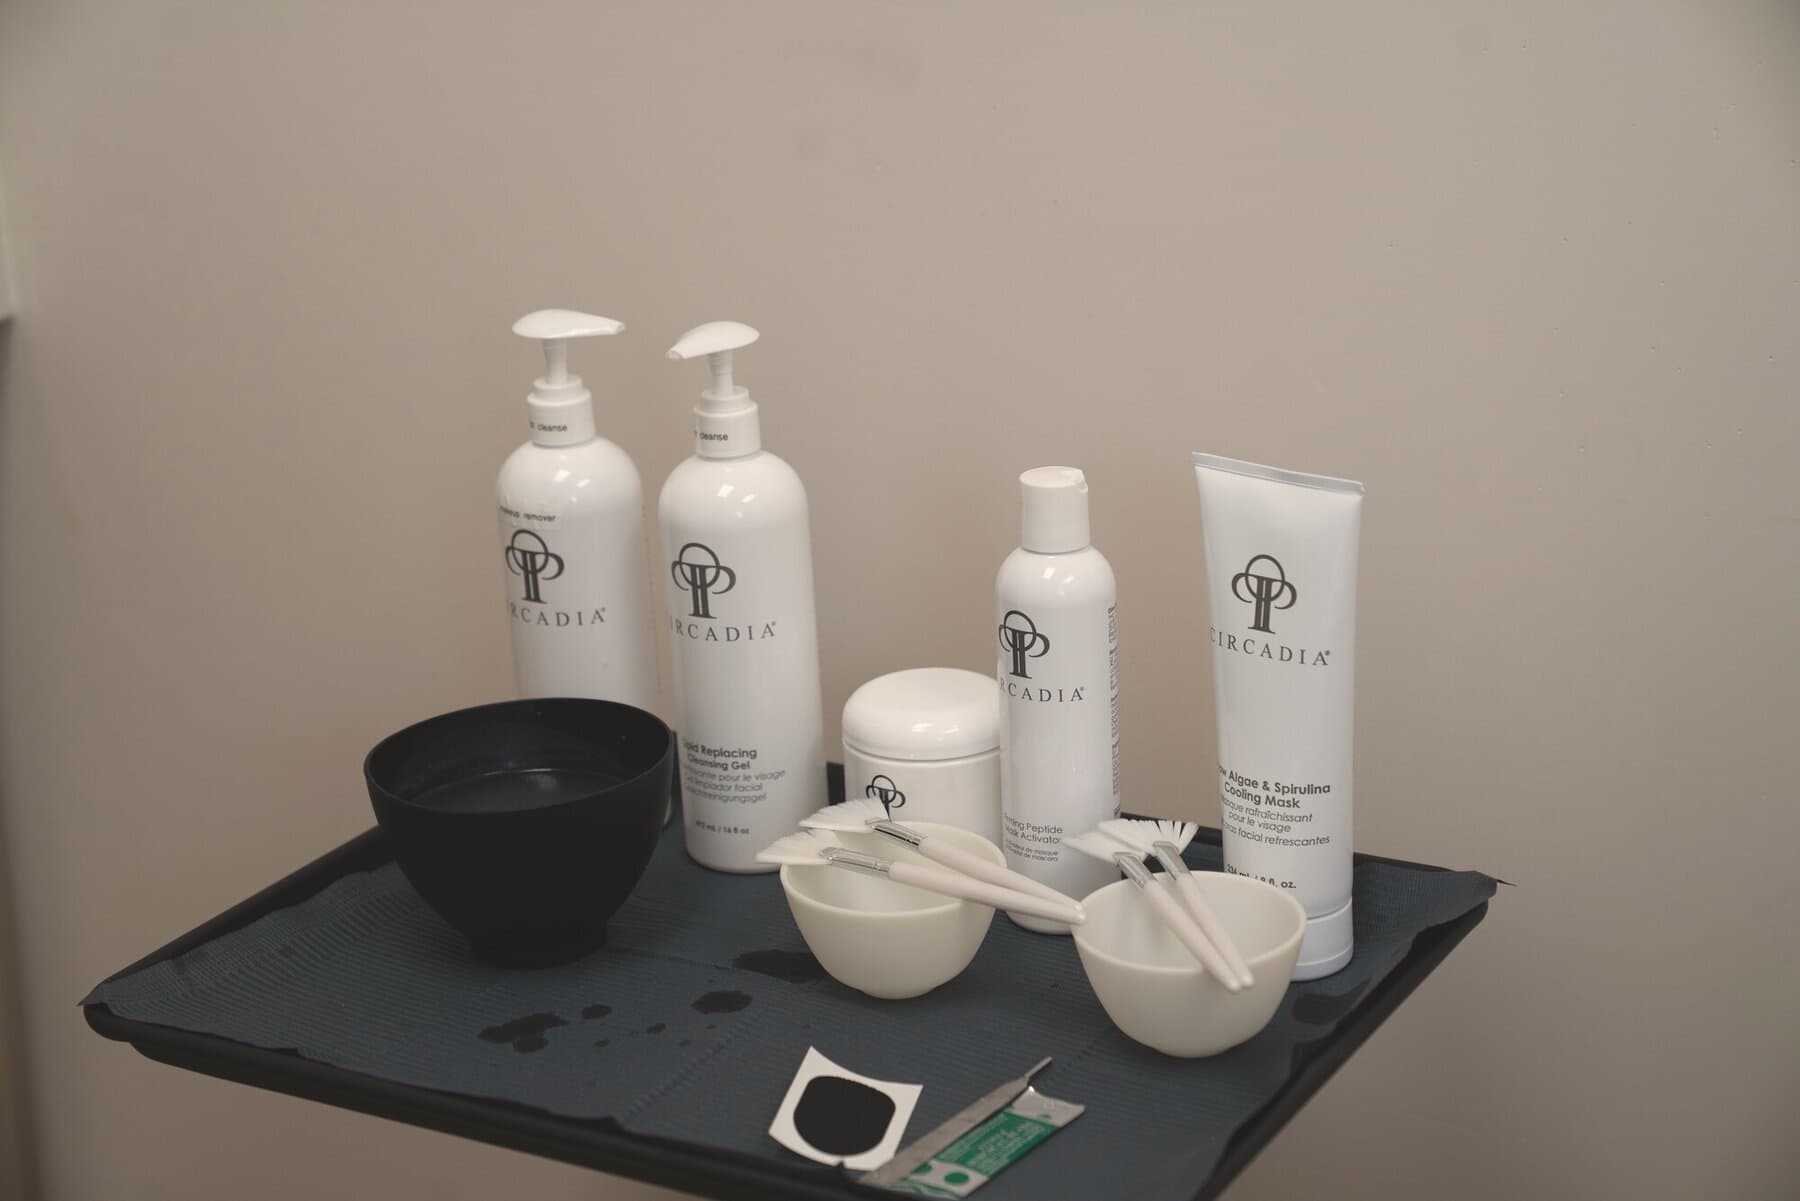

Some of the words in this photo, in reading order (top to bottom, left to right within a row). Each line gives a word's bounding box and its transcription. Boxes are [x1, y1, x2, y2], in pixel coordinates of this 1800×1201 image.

[537, 424, 568, 432] cleanse
[699, 432, 729, 441] cleanse
[700, 744, 757, 760] Replacing
[687, 753, 728, 771] Cleansing
[731, 761, 751, 770] Gel
[718, 774, 741, 782] pour
[742, 773, 752, 781] le
[753, 769, 786, 781] visage
[734, 783, 763, 792] facial
[1229, 770, 1259, 789] Algae
[1262, 780, 1271, 791] &
[1274, 781, 1332, 796] Spirulina
[1224, 776, 1261, 805] Cooling
[1264, 794, 1301, 809] Mask
[1026, 822, 1063, 836] Peptide
[1228, 811, 1246, 824] pour
[1247, 816, 1256, 827] le
[1257, 820, 1292, 834] visage
[1020, 831, 1061, 845] Activato
[1238, 827, 1263, 843] facial
[1264, 836, 1331, 847] refrescantes
[1280, 881, 1297, 889] oz.
